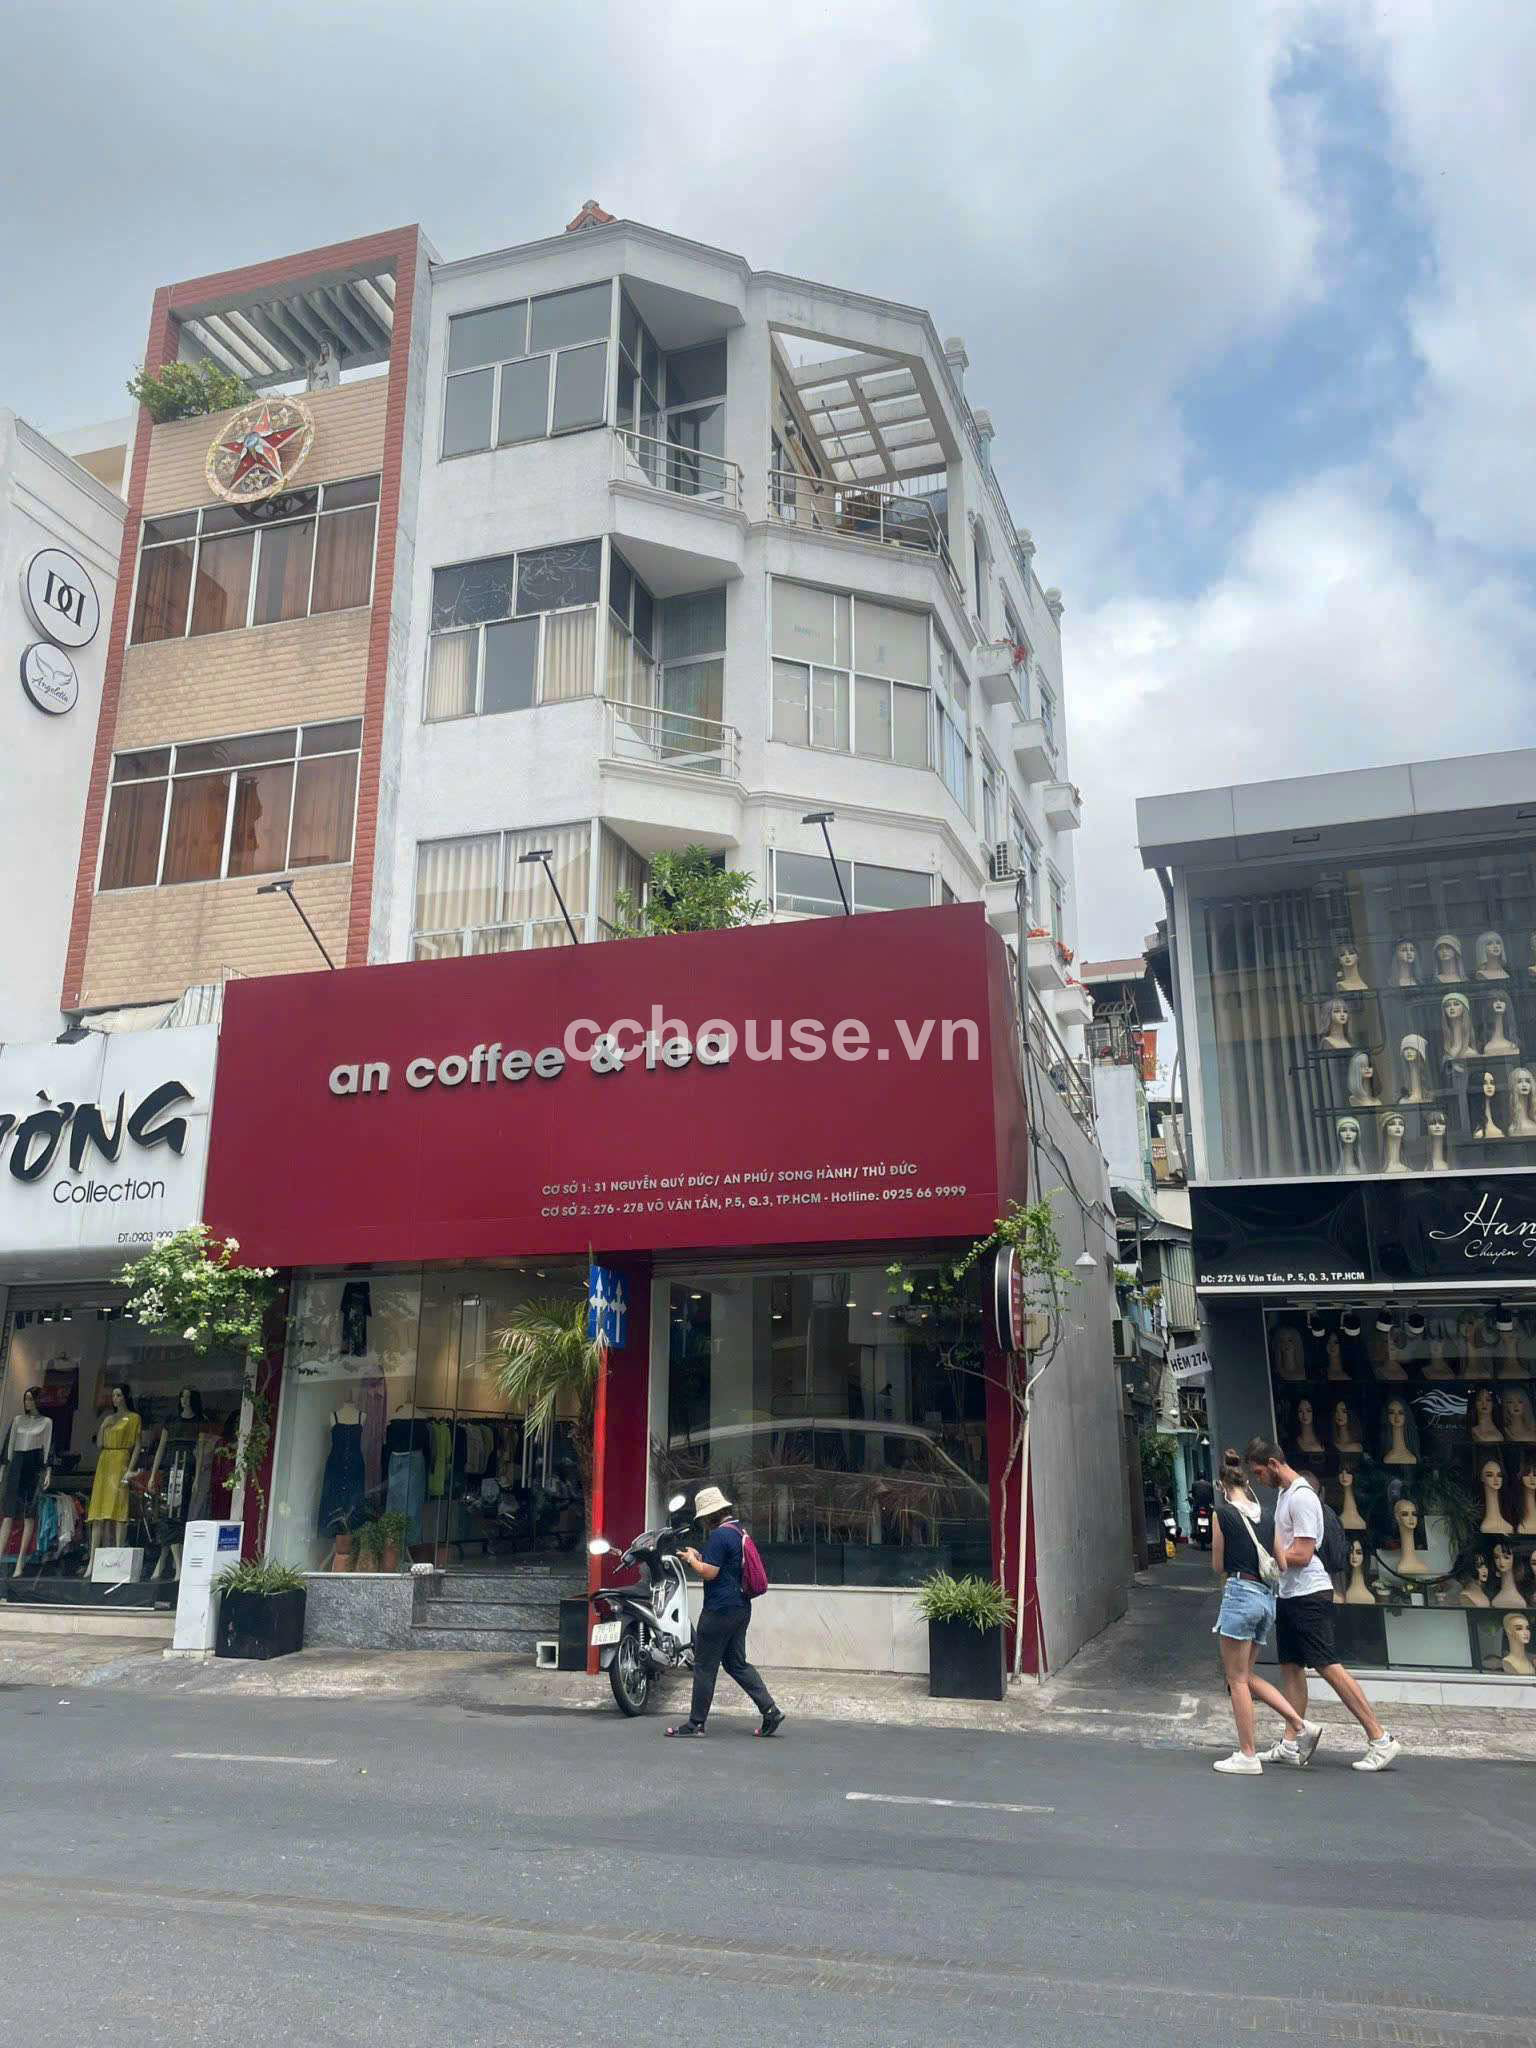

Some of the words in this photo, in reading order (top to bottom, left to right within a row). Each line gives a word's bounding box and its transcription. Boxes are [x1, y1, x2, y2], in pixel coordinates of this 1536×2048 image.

[328, 1061, 391, 1096] an
[405, 1042, 566, 1089] coffee
[589, 1032, 626, 1074] &
[643, 1030, 731, 1071] tea
[53, 1178, 165, 1204] Collection
[562, 1180, 579, 1195] SỞ
[581, 1182, 592, 1193] 1:
[594, 1182, 607, 1192] 31
[610, 1174, 657, 1191] NGUYỄN
[660, 1173, 685, 1189] QUÝ
[688, 1172, 720, 1186] ĐỨC/
[724, 1174, 741, 1184] AN
[744, 1168, 774, 1183] PHÚ/
[777, 1170, 813, 1181] SONG
[816, 1164, 858, 1180] HÀNH/
[862, 1162, 886, 1177] THỦ
[889, 1160, 918, 1176] ĐỨC
[561, 1201, 577, 1216] SỞ
[580, 1205, 592, 1215] 2:
[593, 1204, 615, 1215] 276
[623, 1202, 644, 1214] 278
[725, 1198, 746, 1209] P.5,
[748, 1196, 774, 1208] Q.3,
[776, 1193, 821, 1205] TP.HCM
[831, 1191, 880, 1202] Hotline:
[882, 1188, 913, 1200] 0925
[916, 1187, 932, 1198] 66
[935, 1185, 967, 1197] 9999
[1217, 1274, 1233, 1282] 272
[1287, 1273, 1296, 1281] P.
[1298, 1272, 1307, 1282] 5,
[1309, 1272, 1318, 1281] Q.
[1320, 1272, 1329, 1281] 3,
[1331, 1271, 1365, 1280] TP.HCM
[1191, 1351, 1208, 1367] 274
